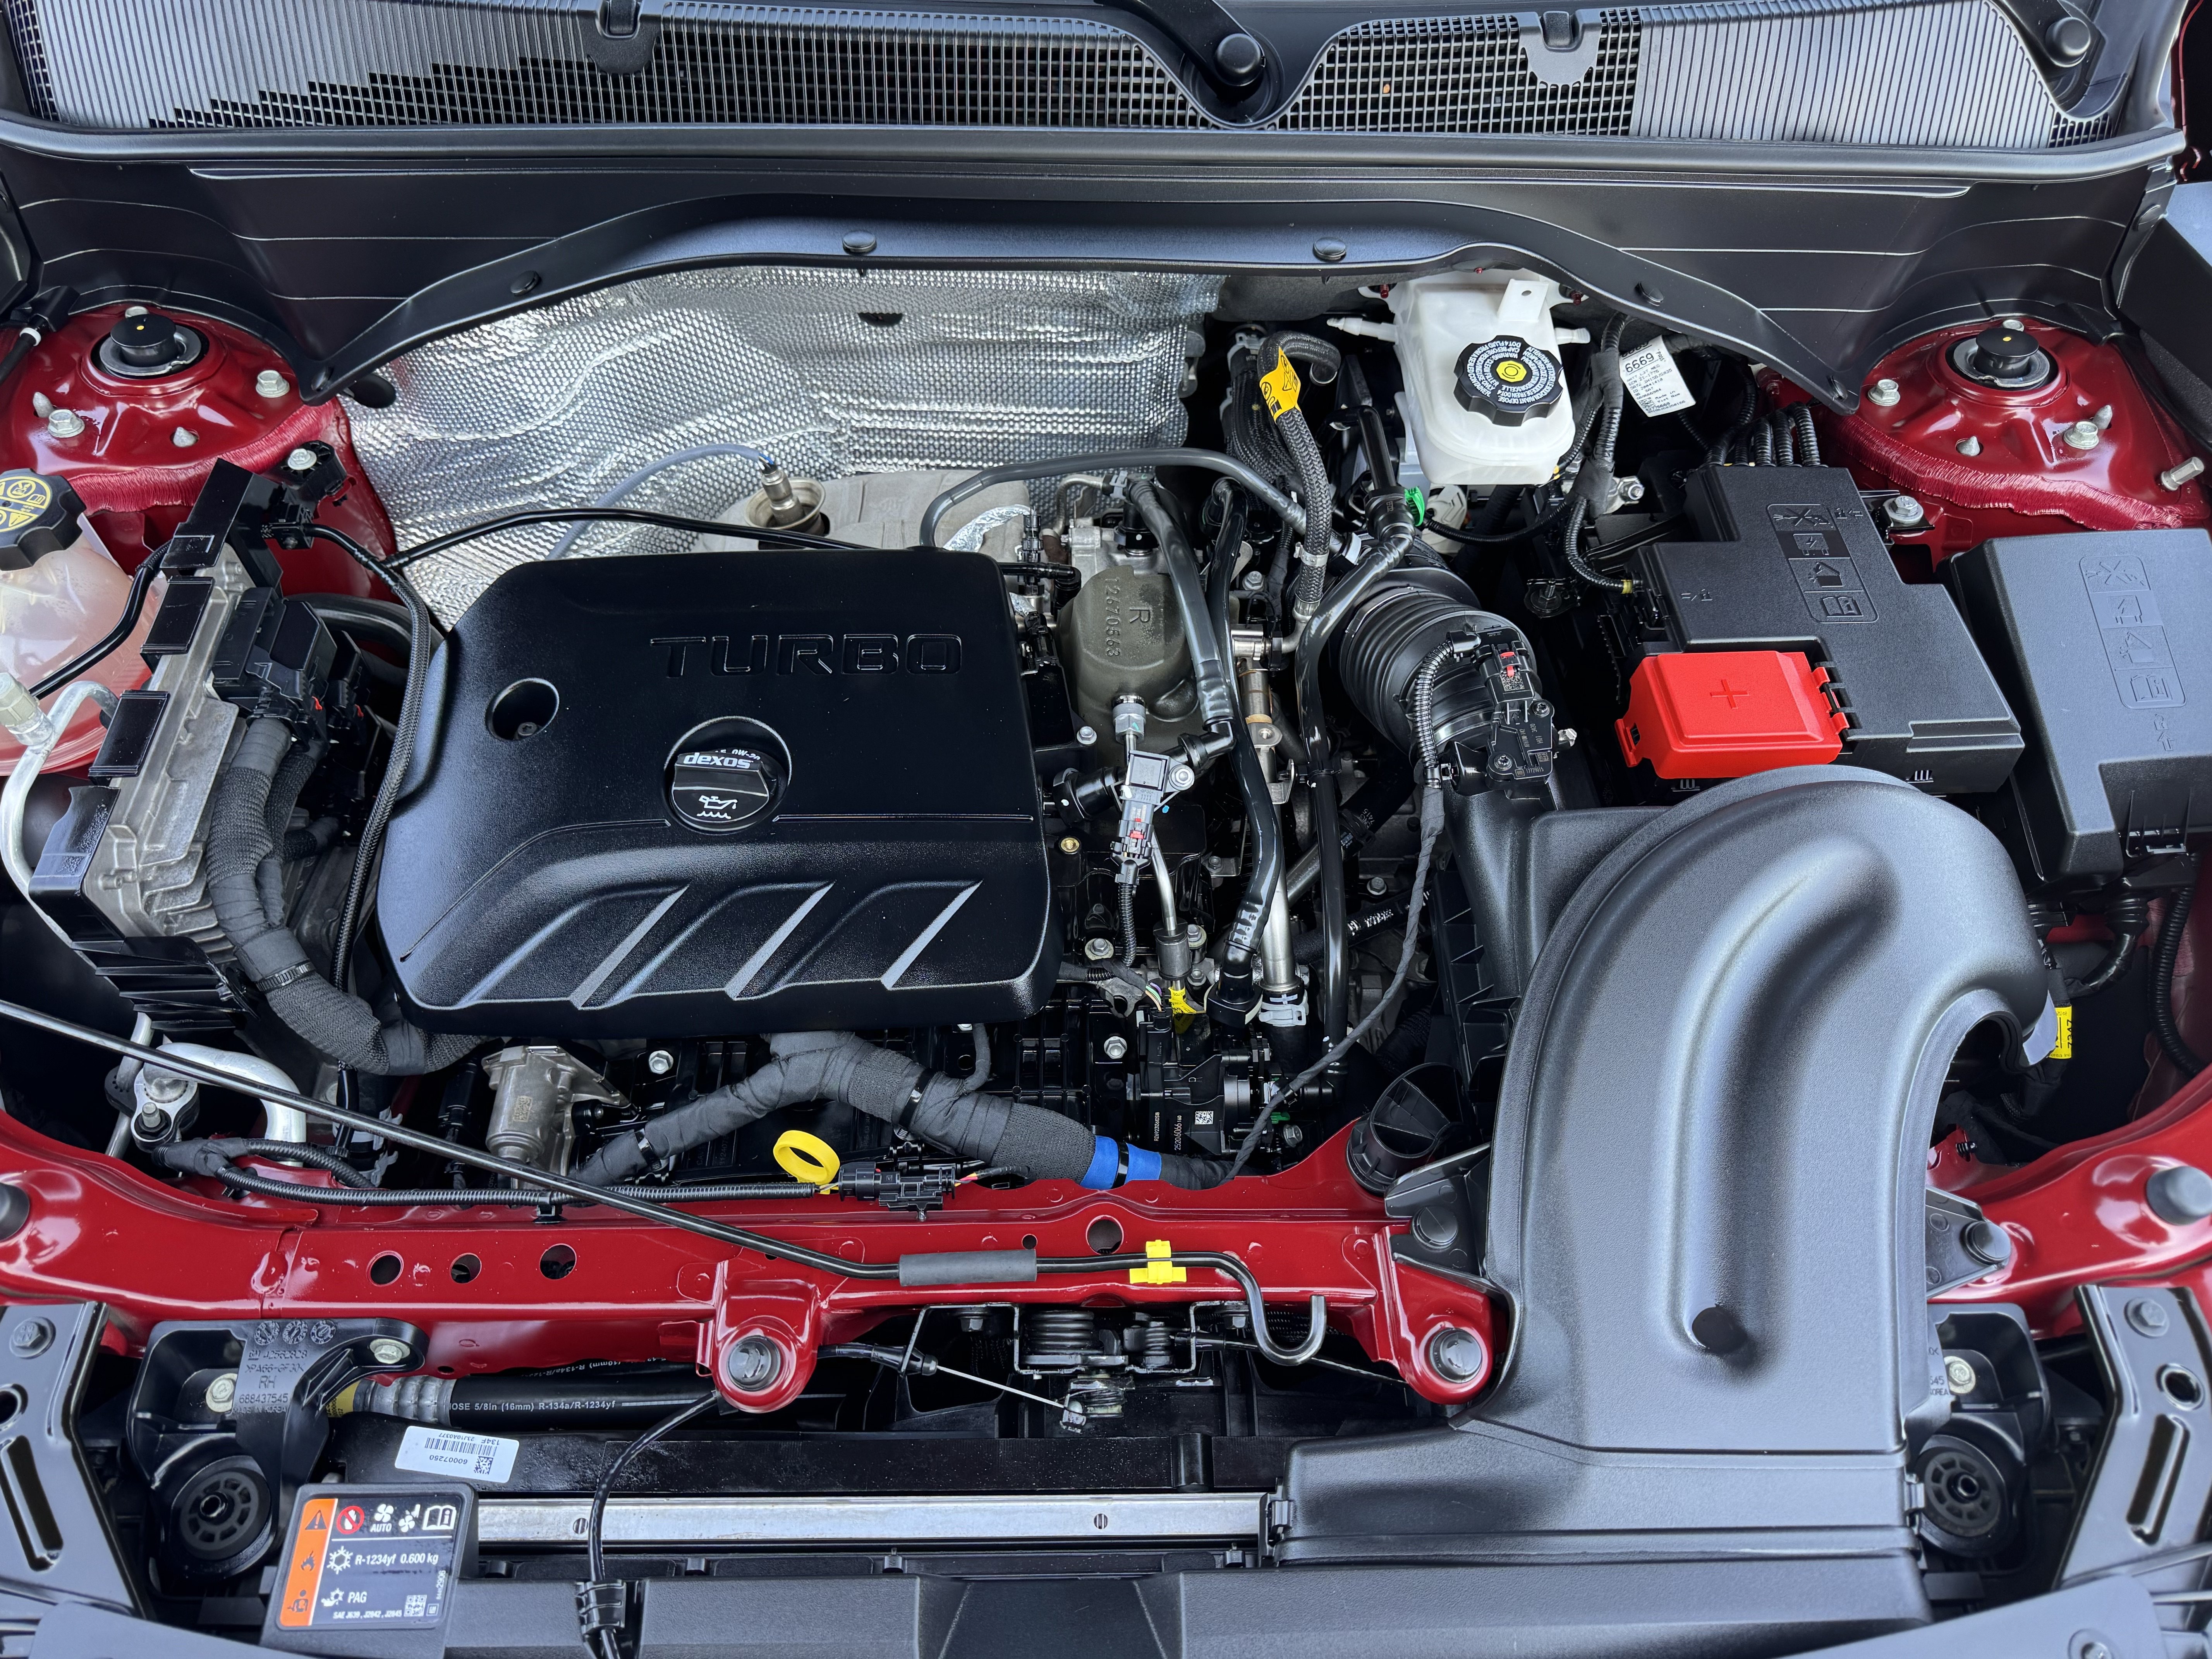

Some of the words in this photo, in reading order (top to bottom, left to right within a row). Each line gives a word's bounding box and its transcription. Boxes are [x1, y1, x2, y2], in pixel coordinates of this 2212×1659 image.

[1625, 353, 1654, 373] 6669
[1105, 577, 1121, 656] 12670563
[1129, 606, 1153, 624] R
[649, 633, 962, 678] TURBO
[259, 1376, 276, 1389] RH
[239, 1393, 288, 1403] 688437545
[501, 1403, 534, 1412] (16mm)
[538, 1400, 616, 1410] R-134a/R-1234yf
[429, 1455, 468, 1465] 60007250
[370, 1523, 392, 1533] AUTO
[355, 1554, 396, 1566] R-1234yf
[400, 1553, 425, 1564] 0.600
[427, 1553, 439, 1565] kg
[348, 1592, 367, 1603] PAG
